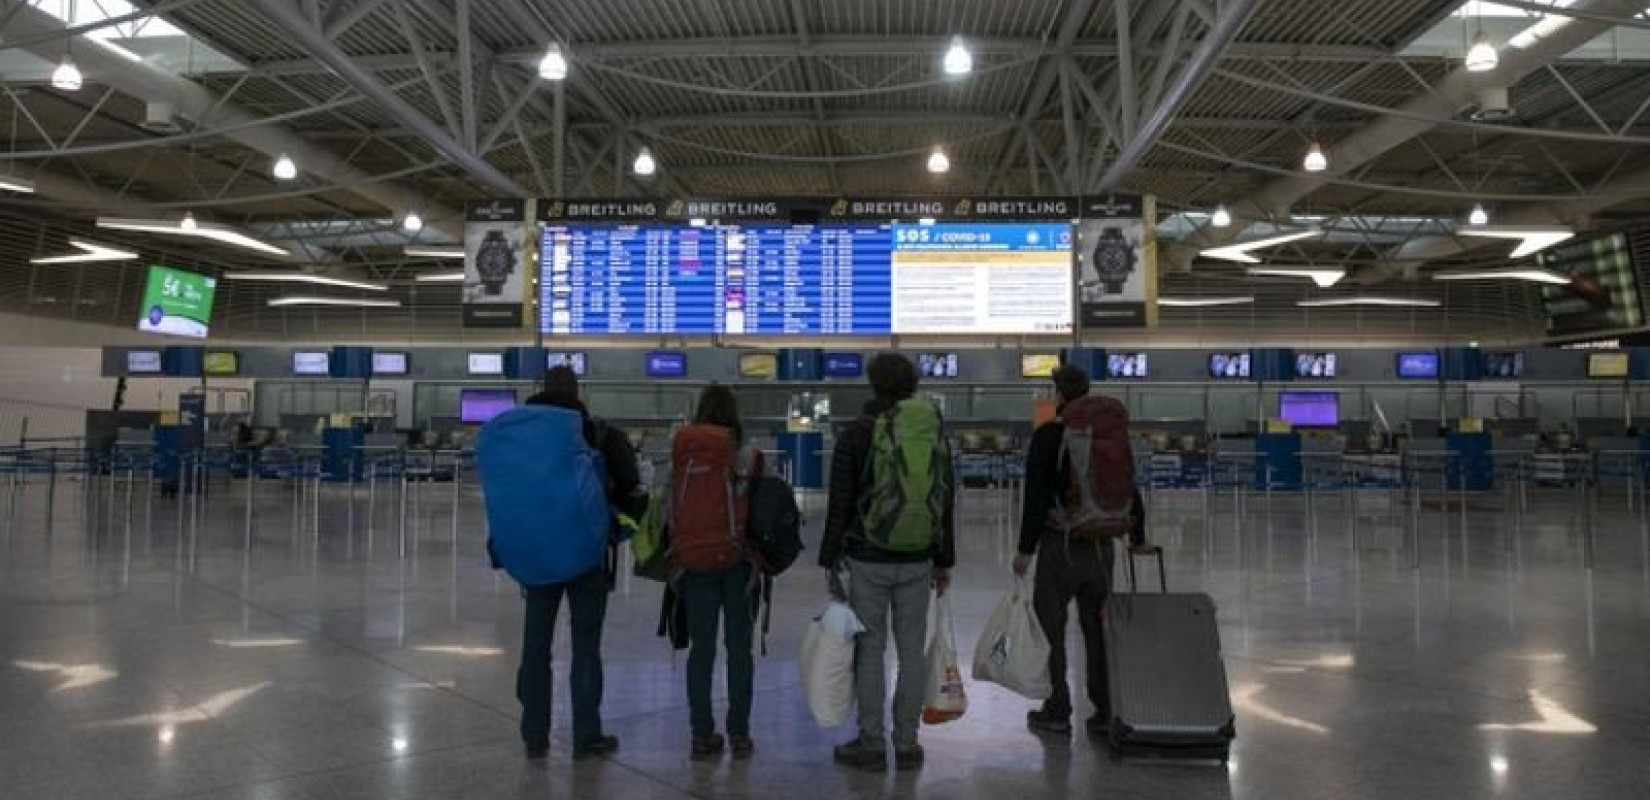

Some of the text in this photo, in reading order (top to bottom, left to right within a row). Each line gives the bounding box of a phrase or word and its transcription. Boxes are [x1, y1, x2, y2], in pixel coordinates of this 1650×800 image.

[567, 203, 657, 216] BREITLING
[688, 202, 777, 215] BREITLING
[852, 201, 944, 214] BREITLING
[975, 201, 1068, 214] BREITLING
[896, 228, 930, 243] SOS
